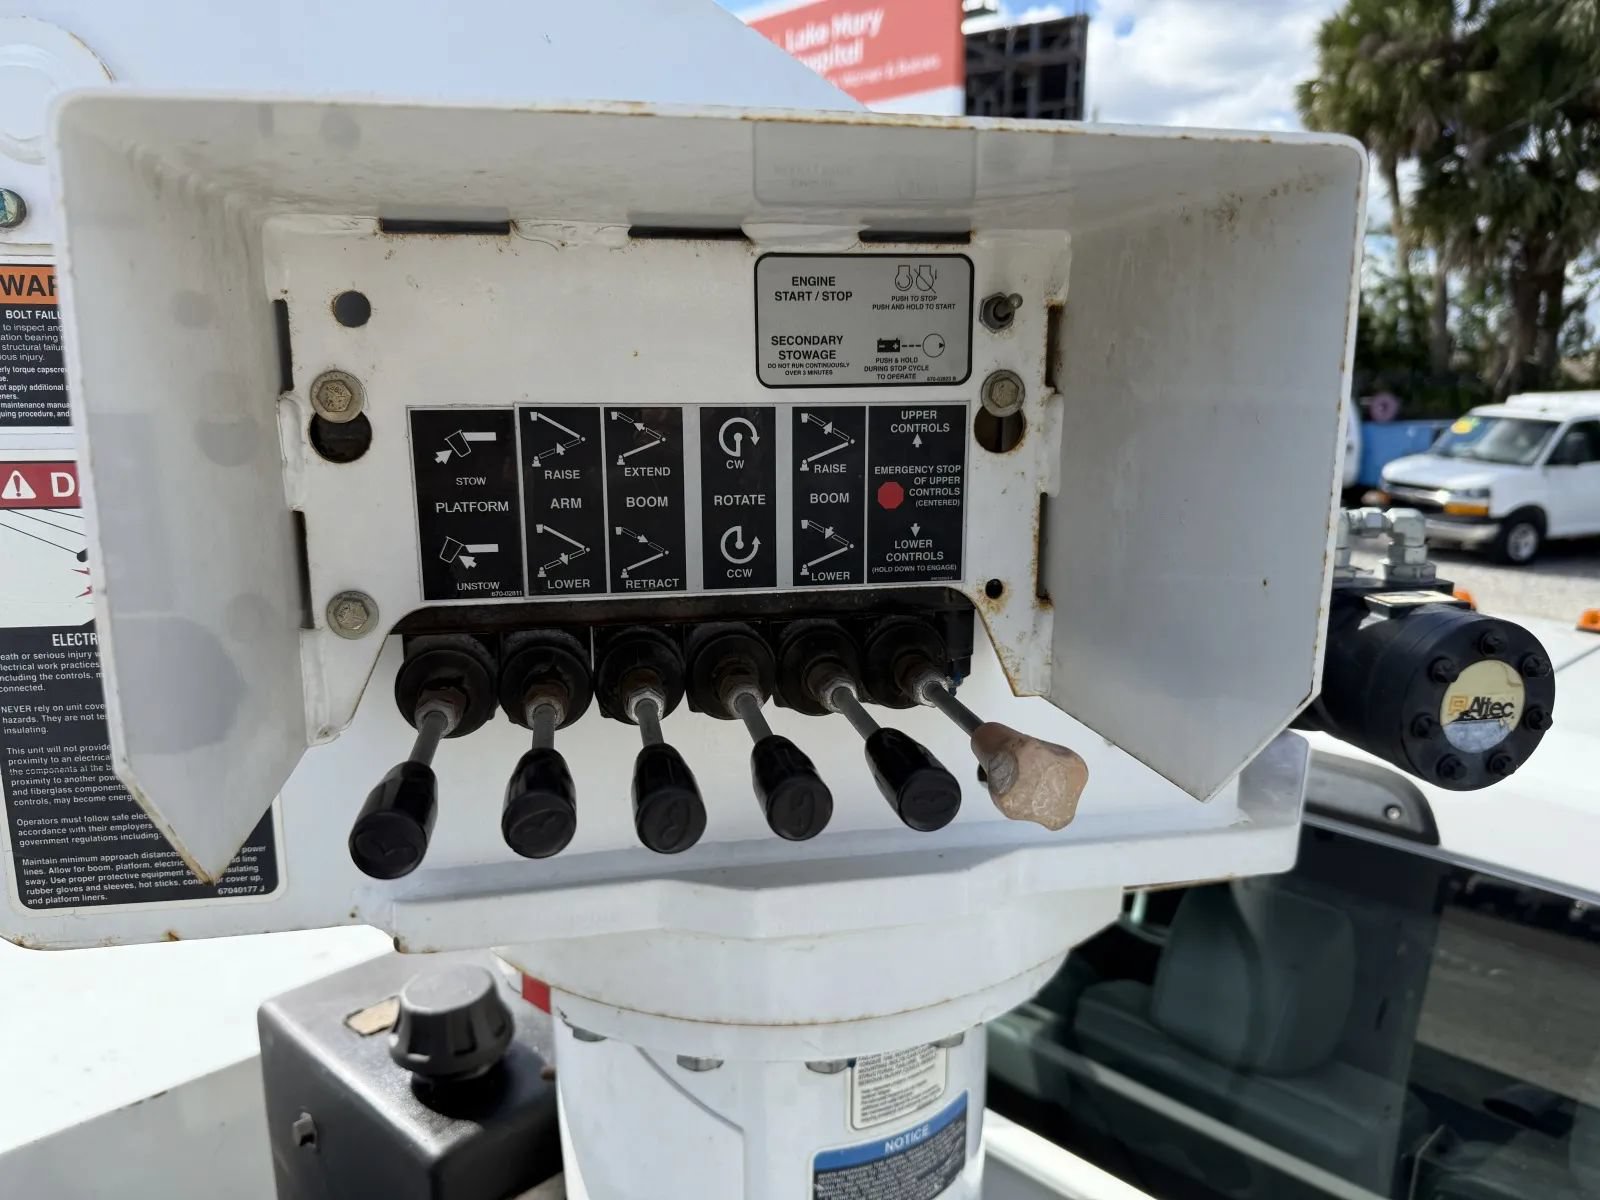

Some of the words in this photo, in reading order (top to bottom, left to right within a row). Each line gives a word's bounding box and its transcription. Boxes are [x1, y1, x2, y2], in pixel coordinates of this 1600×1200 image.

[832, 8, 884, 38] Mary
[792, 276, 836, 286] ENGINE
[774, 291, 812, 301] START
[814, 291, 819, 301] /
[822, 291, 853, 302] STOP
[6, 310, 32, 319] BOLT
[14, 324, 45, 332] inspect
[25, 334, 58, 342] bearing
[771, 335, 843, 345] SECONDARY
[20, 353, 45, 362] injury.
[778, 350, 836, 360] STOWAGE
[12, 366, 35, 374] torque
[9, 384, 28, 392] apply
[18, 410, 56, 419] procedure,
[901, 410, 938, 420] UPPER
[890, 423, 950, 433] CONTROLS
[726, 460, 744, 469] CW
[814, 464, 847, 474] RAISE
[874, 465, 934, 475] EMERGENCY
[936, 464, 961, 474] STOP
[544, 470, 581, 480] RAISE
[624, 467, 671, 477] EXTEND
[456, 477, 487, 486] STOW
[914, 476, 927, 485] OF
[929, 476, 961, 484] UPPER
[908, 488, 961, 496] CONTROLS
[550, 498, 582, 509] ARM
[626, 496, 668, 508] BOOM
[714, 494, 766, 506] ROTATE
[809, 493, 850, 504] BOOM
[915, 499, 960, 508] (CENTERED)
[435, 501, 509, 513] PLATFORM
[894, 540, 933, 550] LOWER
[886, 551, 944, 562] CONTROLS
[726, 569, 752, 578] CCW
[811, 571, 850, 581] LOWER
[457, 582, 500, 591] UNSTOW
[547, 578, 591, 590] LOWER
[625, 578, 680, 589] RETRACT
[68, 651, 92, 660] injury
[1, 705, 31, 713] NEVER
[34, 705, 50, 713] rely
[1469, 696, 1514, 718] Altec
[2, 715, 39, 724] hazards.
[41, 715, 62, 723] They
[4, 727, 48, 735] insulating.
[6, 747, 25, 755] This
[80, 744, 112, 753] provide
[8, 757, 48, 766] proximity
[26, 766, 78, 775] components
[11, 777, 50, 787] proximity
[64, 775, 96, 783] another
[30, 787, 72, 796] fiberglass
[75, 784, 126, 793] components
[16, 818, 58, 827] Operators
[18, 828, 66, 836] accordance
[110, 823, 153, 832] employers
[20, 838, 69, 847] government
[71, 835, 118, 844] regulations
[60, 856, 98, 864] minimum
[100, 852, 139, 862] approach
[68, 876, 95, 884] proper
[98, 873, 139, 883] protective
[141, 870, 184, 878] equipment
[56, 886, 83, 894] gloves
[45, 896, 80, 906] platform
[884, 1124, 929, 1154] NOTICE
